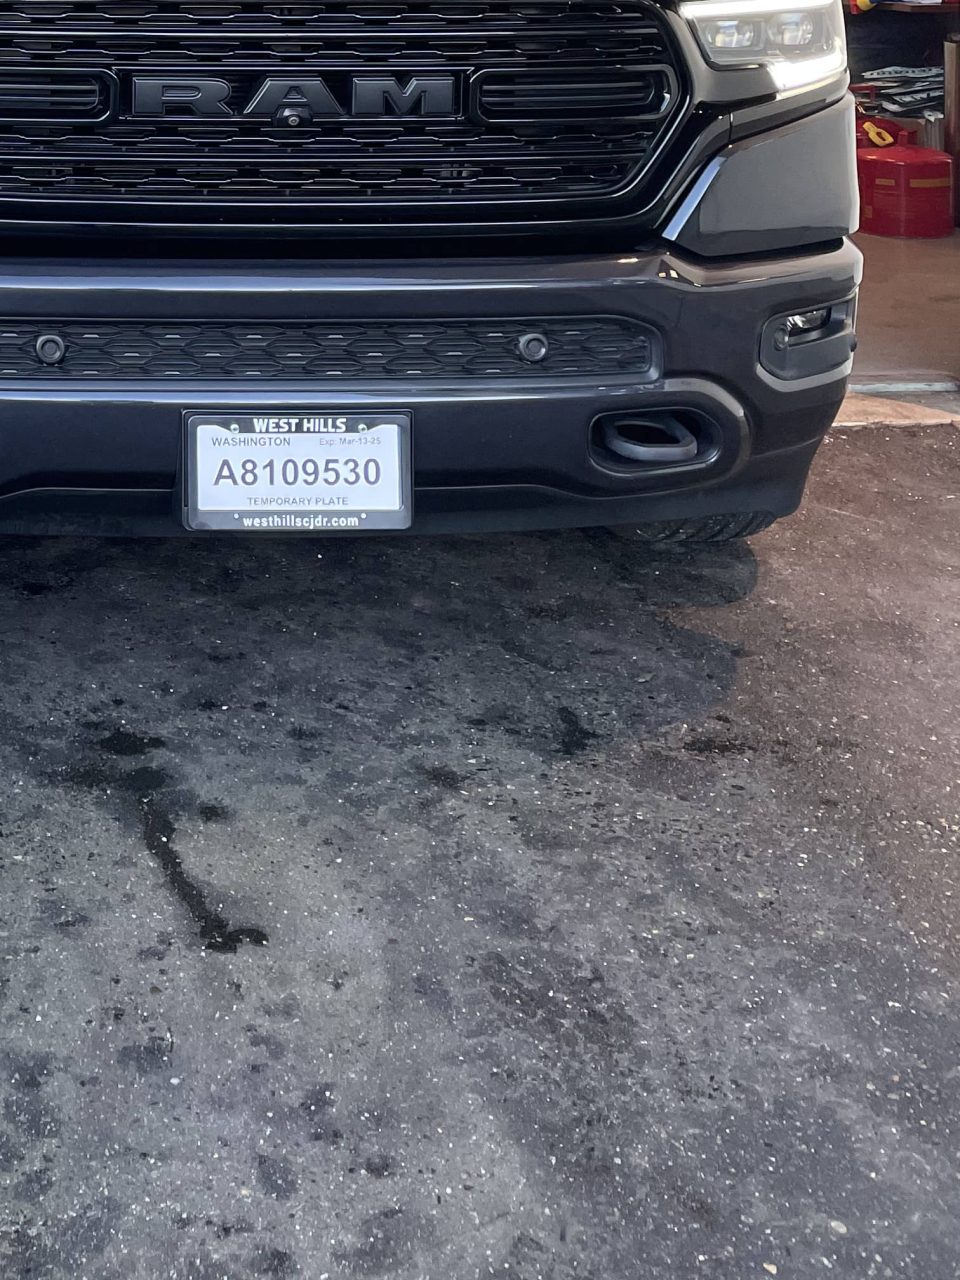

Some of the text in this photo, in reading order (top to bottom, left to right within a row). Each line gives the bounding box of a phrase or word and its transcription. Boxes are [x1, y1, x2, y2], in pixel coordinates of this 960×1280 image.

[132, 76, 456, 117] RAM
[253, 417, 347, 433] WEST HILLS
[211, 436, 382, 447] WASHINGTON Exp: Mar-13-25
[213, 458, 381, 486] A8109530
[247, 496, 349, 506] TEMPORARY PLATE
[243, 515, 359, 529] westhillscjdr.com
